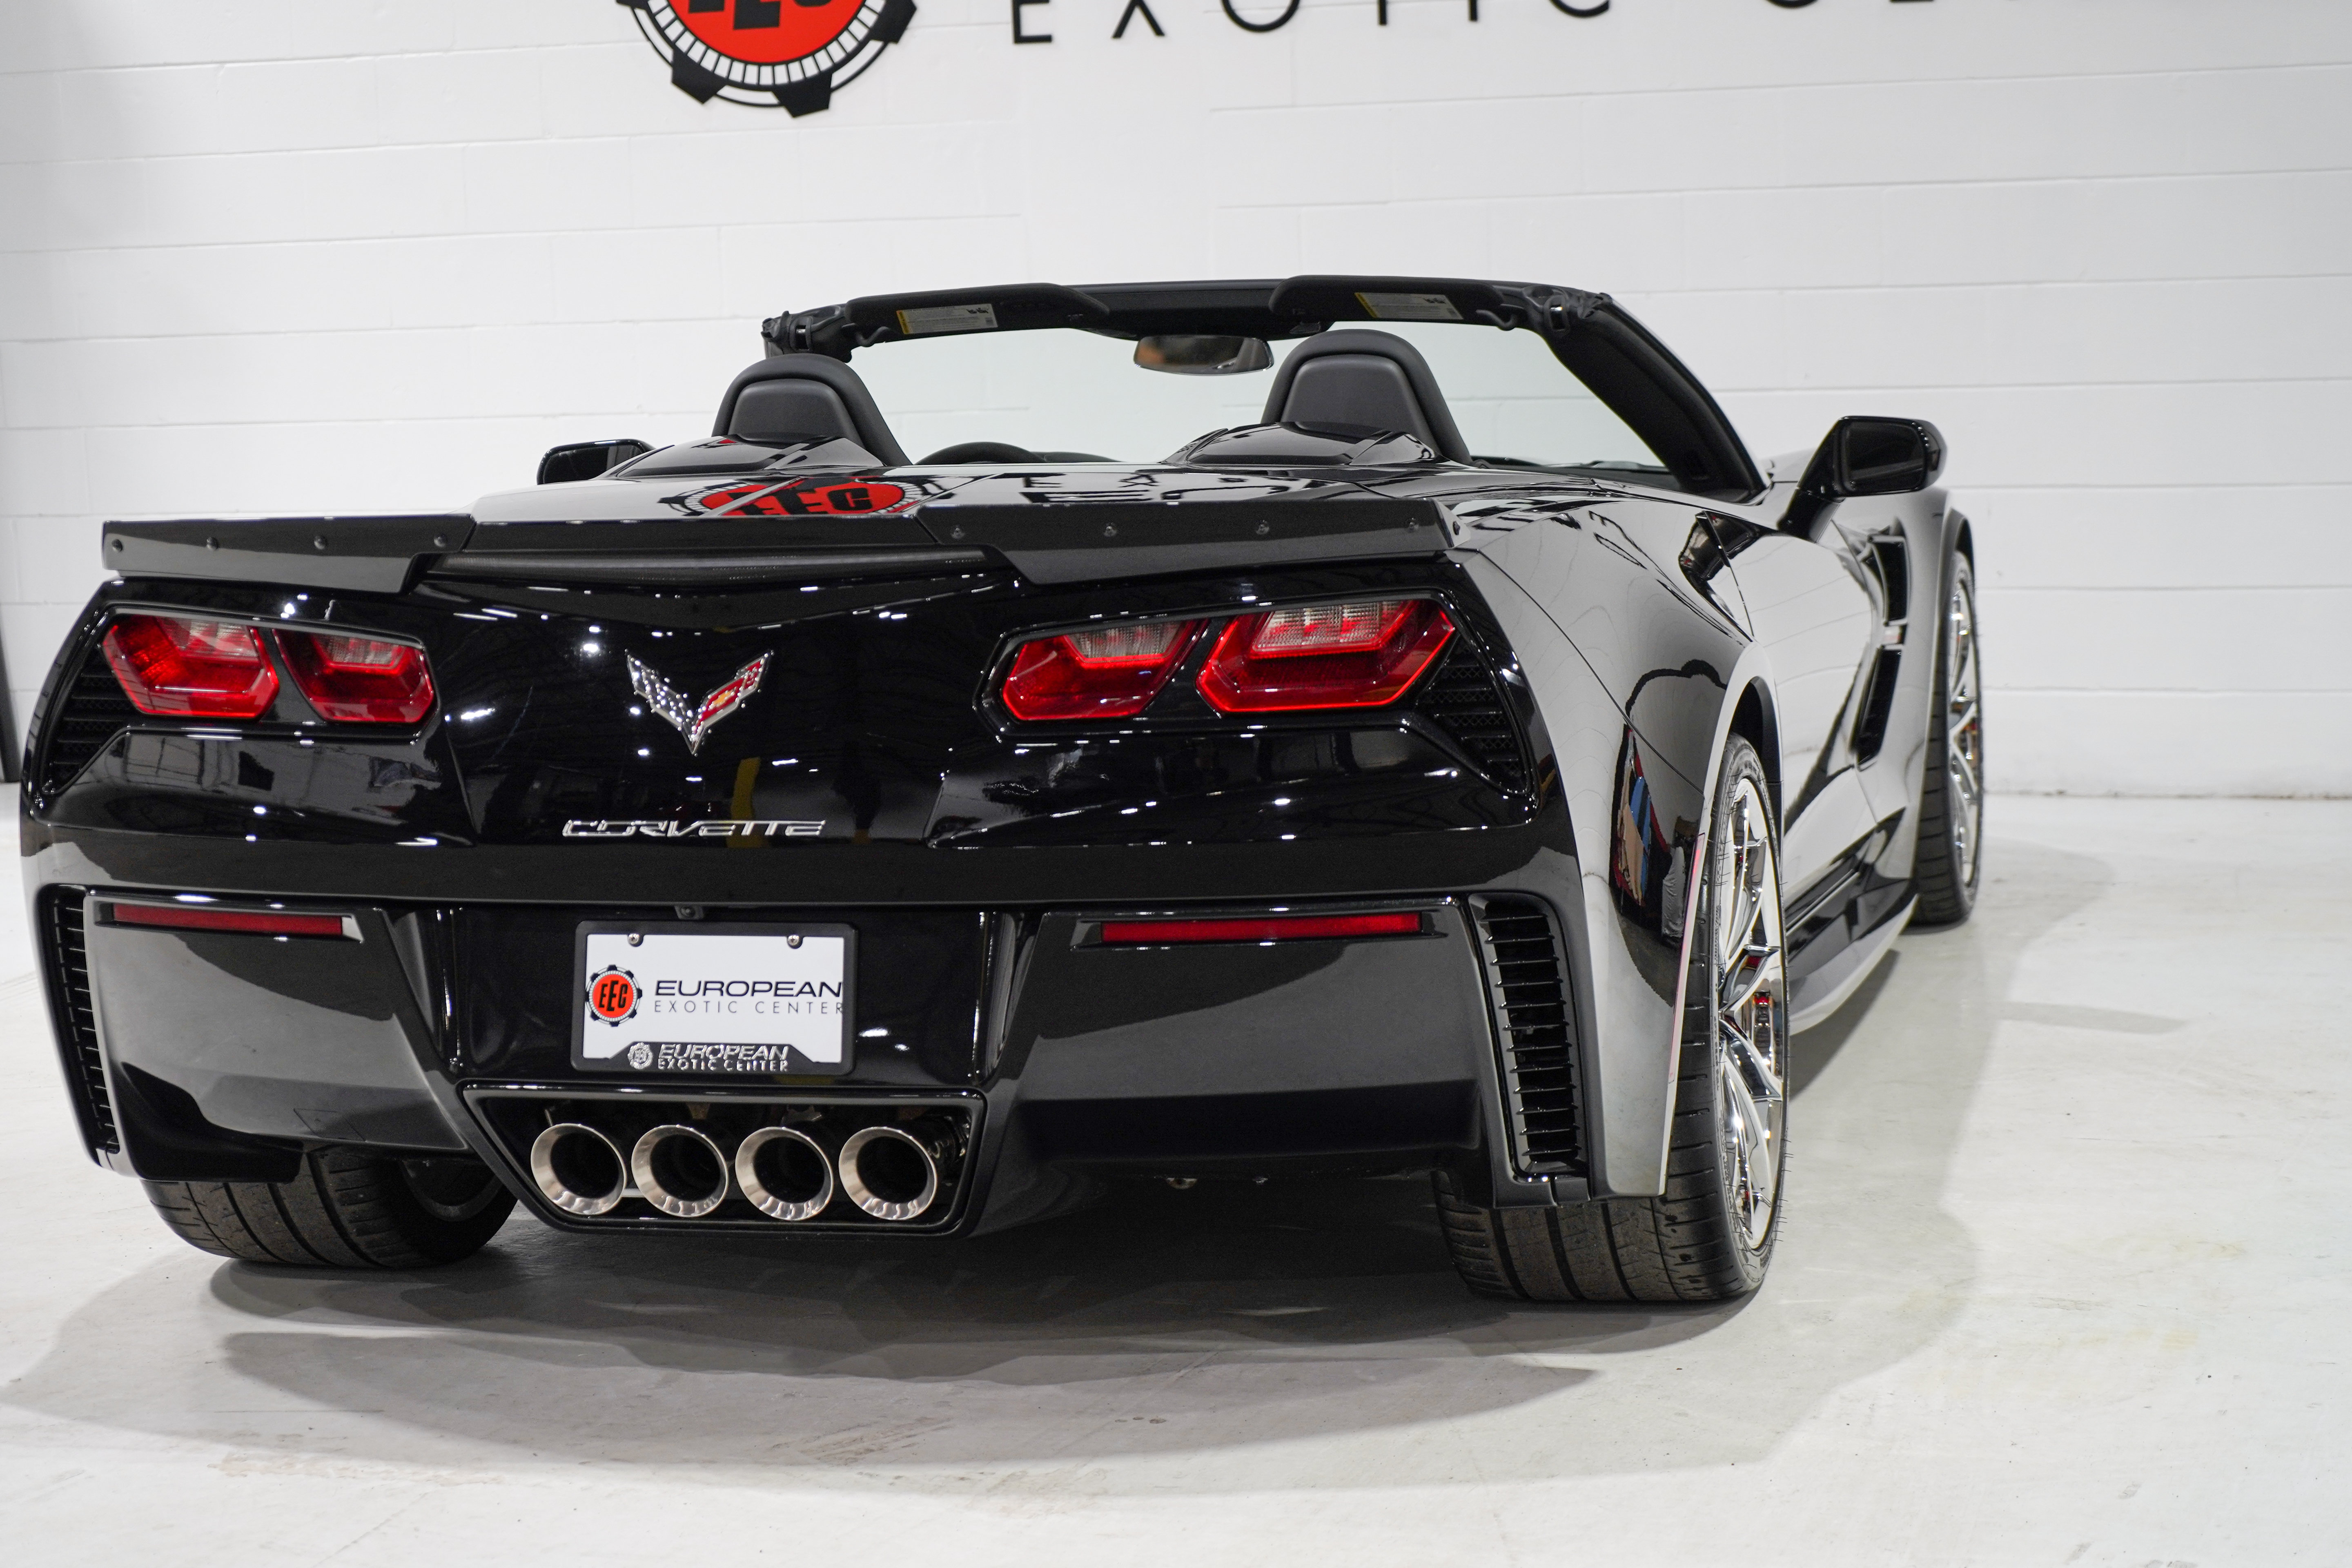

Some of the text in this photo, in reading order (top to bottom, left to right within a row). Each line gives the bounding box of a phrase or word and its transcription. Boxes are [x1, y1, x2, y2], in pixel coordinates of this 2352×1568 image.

[562, 820, 826, 837] CORVETTE
[655, 980, 842, 998] EUROPEAN
[654, 1000, 843, 1014] EXOTIC CENTER
[658, 1043, 789, 1060] EUROPEAN
[658, 1058, 788, 1072] EXOTIC CENTER
